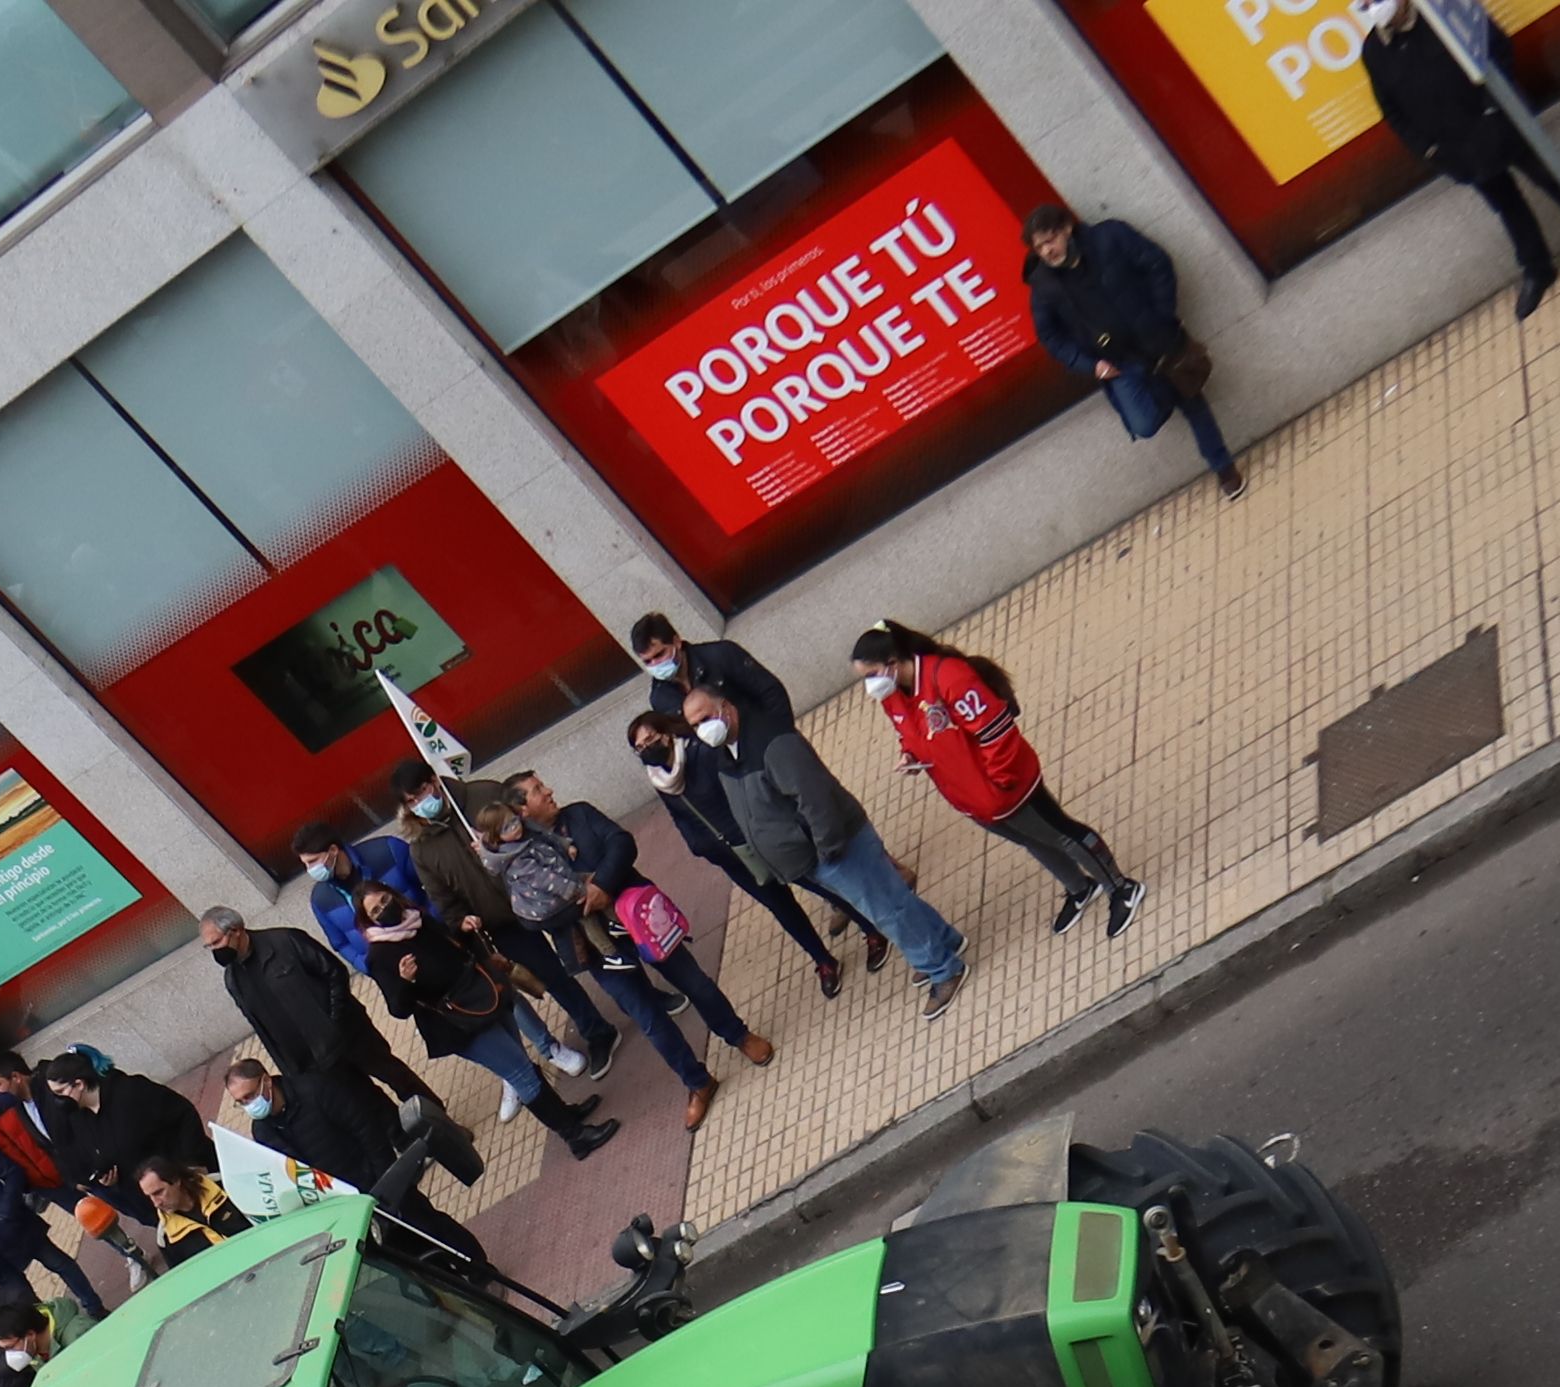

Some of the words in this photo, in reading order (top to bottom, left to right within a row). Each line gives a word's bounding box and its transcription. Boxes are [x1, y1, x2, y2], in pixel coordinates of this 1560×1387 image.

[664, 255, 884, 419] PORQUE
[869, 197, 956, 277] TÚ
[705, 304, 926, 468] PORQUE
[911, 258, 997, 327] TE
[954, 689, 987, 722] 92
[20, 843, 55, 870] desde
[5, 865, 51, 902] principio
